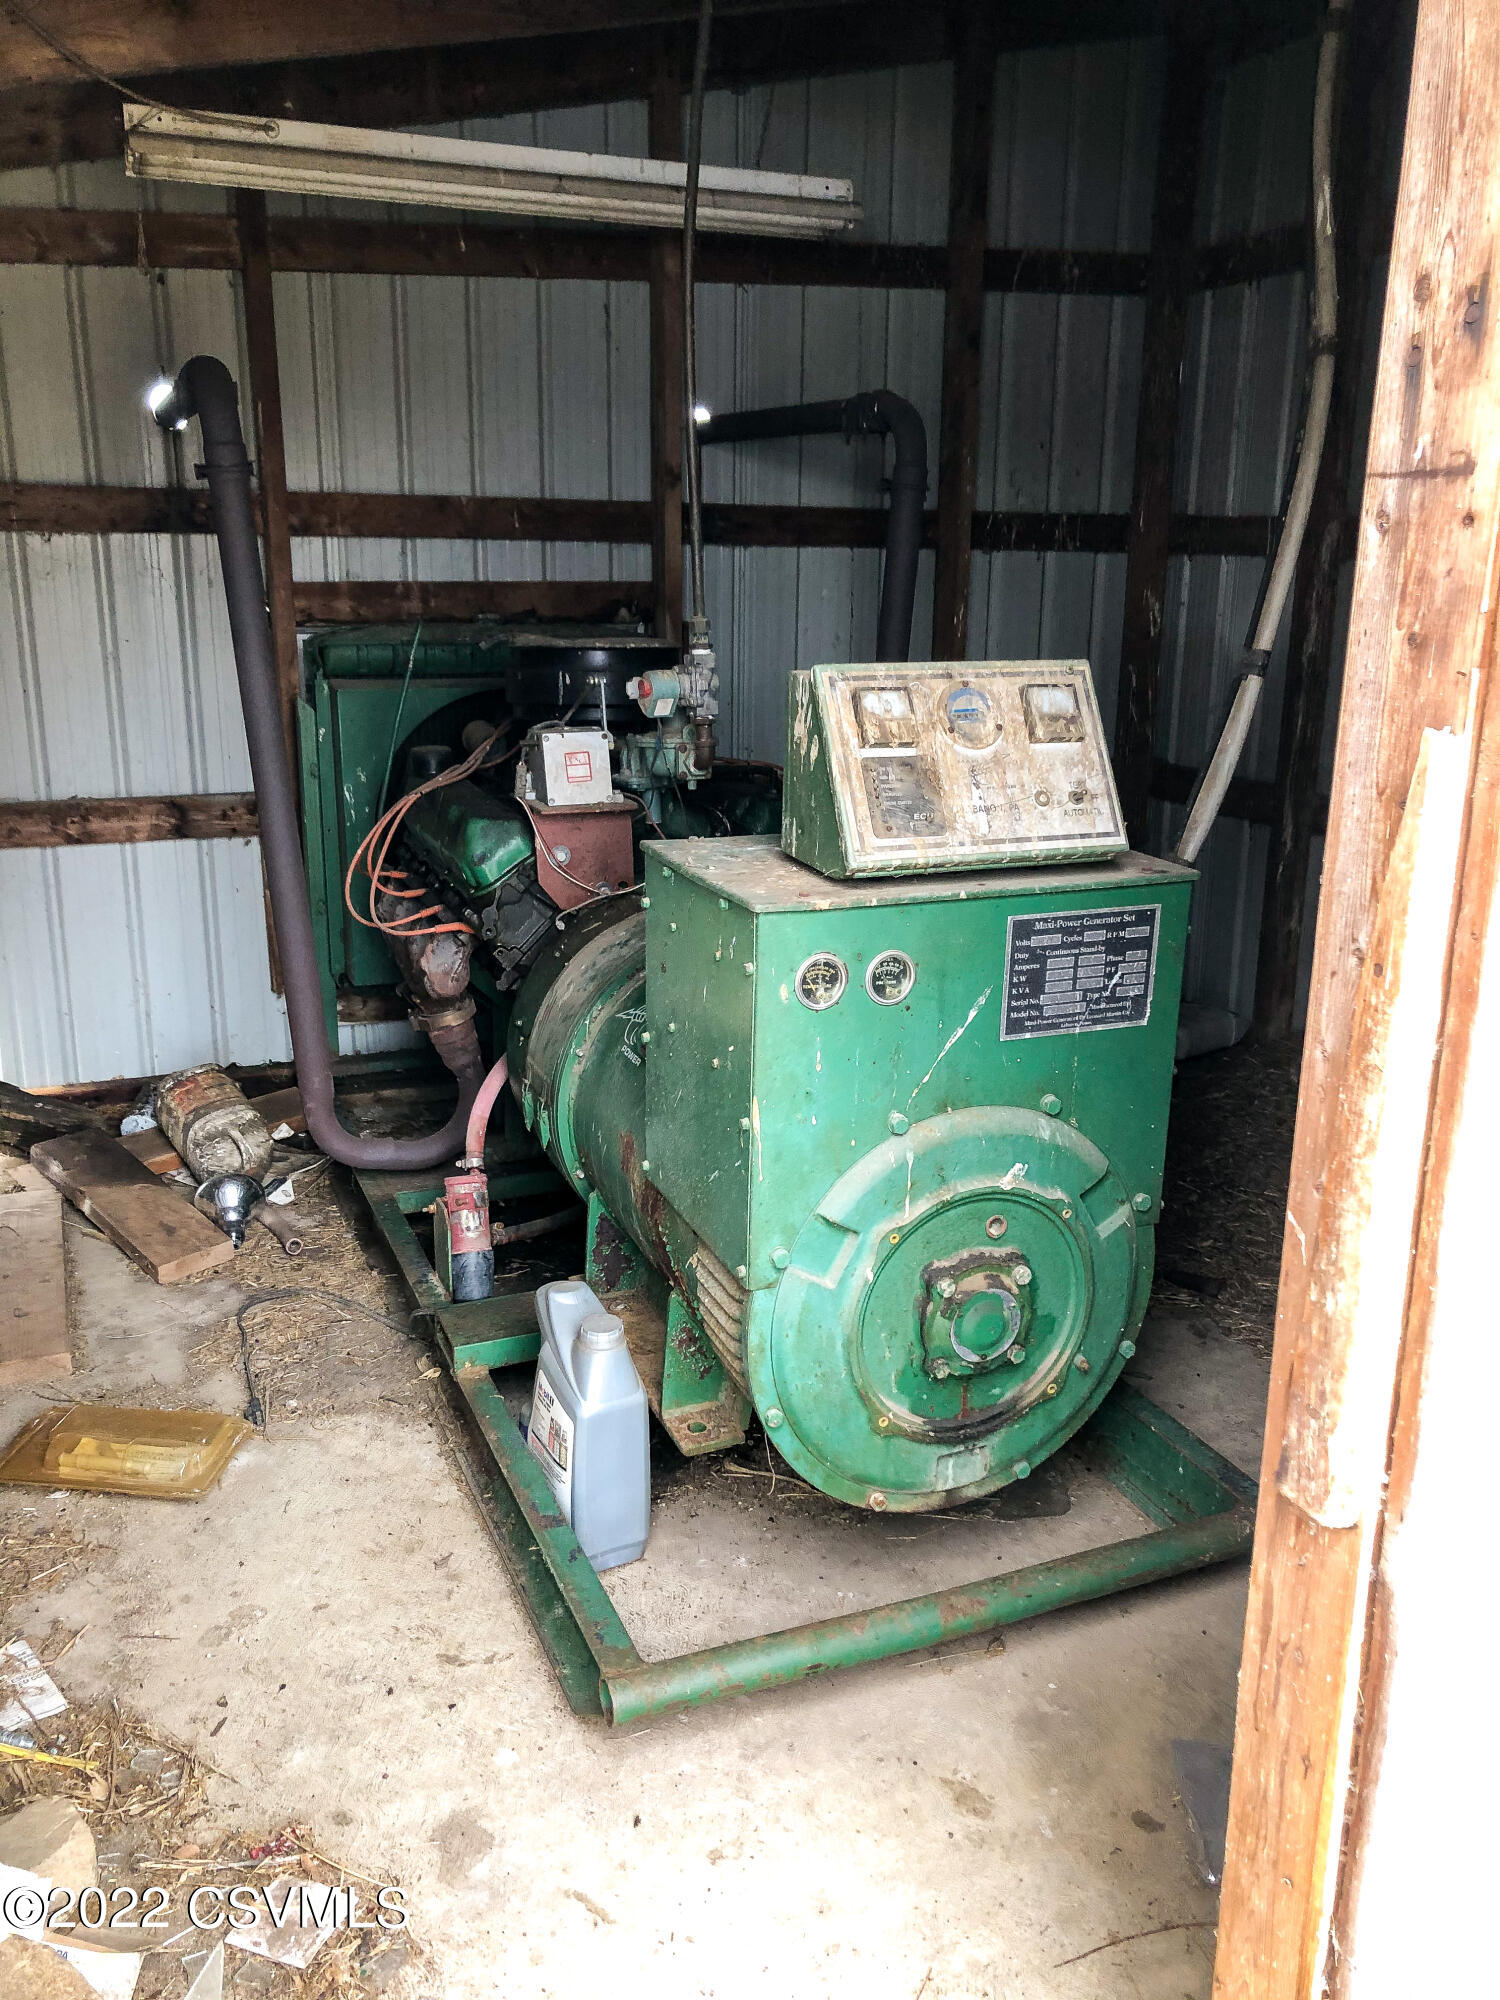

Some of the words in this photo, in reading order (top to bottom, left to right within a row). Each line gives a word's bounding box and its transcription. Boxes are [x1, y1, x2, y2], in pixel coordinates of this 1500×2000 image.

[1083, 914, 1123, 926] Generator
[1123, 913, 1136, 922] Set
[1015, 939, 1031, 947] Volts
[1063, 934, 1083, 944] Cycles
[1014, 952, 1030, 960] Duty
[1046, 948, 1080, 956] Continuous
[1013, 963, 1041, 972] Amperes
[1106, 954, 1125, 962] Phase
[1010, 1009, 1029, 1019] Model
[620, 1044, 642, 1067] POWER
